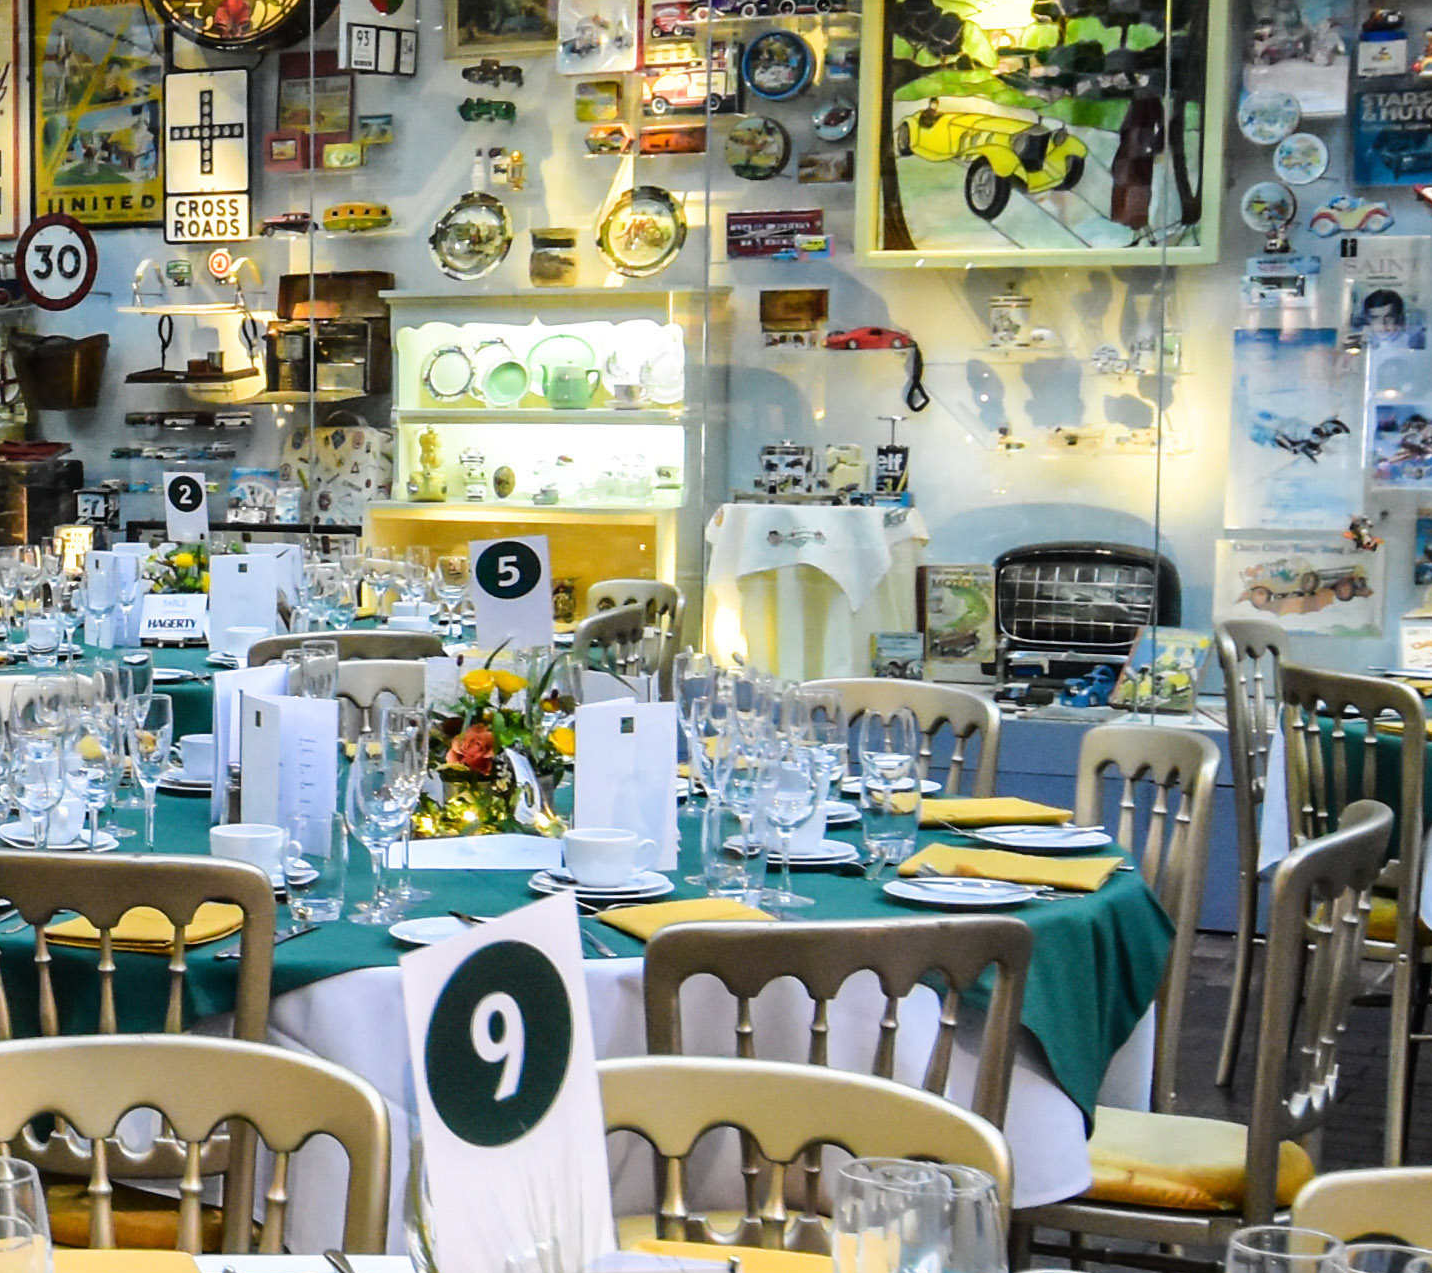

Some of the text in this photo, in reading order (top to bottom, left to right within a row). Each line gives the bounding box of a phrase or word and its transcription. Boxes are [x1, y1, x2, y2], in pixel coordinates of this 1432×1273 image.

[356, 29, 370, 47] 93
[46, 193, 157, 214] UNITED
[174, 195, 240, 218] CROSS
[173, 216, 241, 239] ROADS
[32, 243, 83, 281] 30
[1343, 258, 1419, 274] SAINT
[877, 451, 903, 472] elf
[177, 485, 193, 505] 2
[496, 555, 522, 588] 5
[146, 617, 198, 631] HAGERTY
[468, 991, 528, 1104] 9
